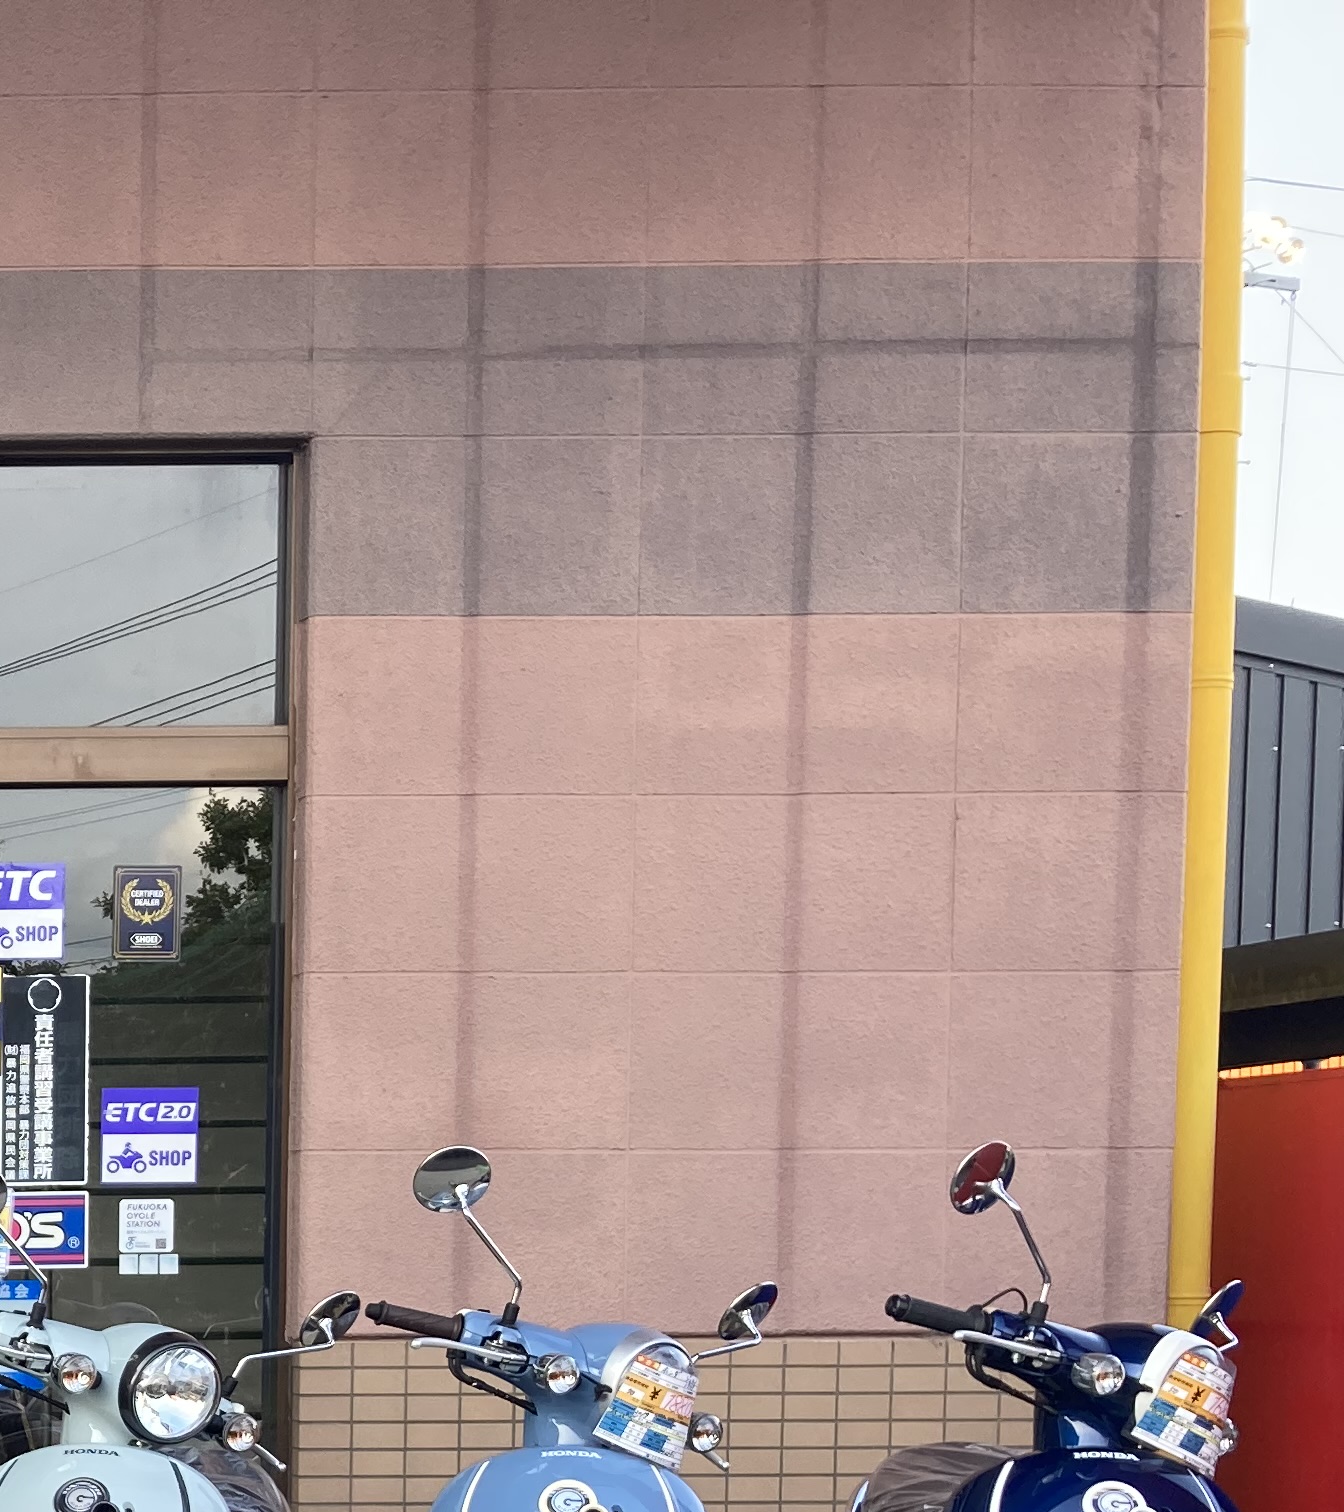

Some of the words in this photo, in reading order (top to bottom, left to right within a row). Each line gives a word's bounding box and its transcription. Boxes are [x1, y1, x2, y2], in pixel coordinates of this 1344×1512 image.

[131, 889, 164, 898] CERTIFIED
[134, 898, 160, 907] DEALER
[15, 925, 59, 942] SHOP
[134, 935, 159, 944] SHOEI
[103, 1103, 157, 1122] ETC
[161, 1105, 192, 1119] 2.0
[148, 1150, 192, 1166] SHOP
[127, 1203, 168, 1211] FUKUOKA
[126, 1212, 156, 1220] CYCLE
[126, 1220, 161, 1228] STATION
[63, 1448, 120, 1457] HONDA
[541, 1450, 602, 1459] HONDA
[1073, 1451, 1141, 1461] HONDA
